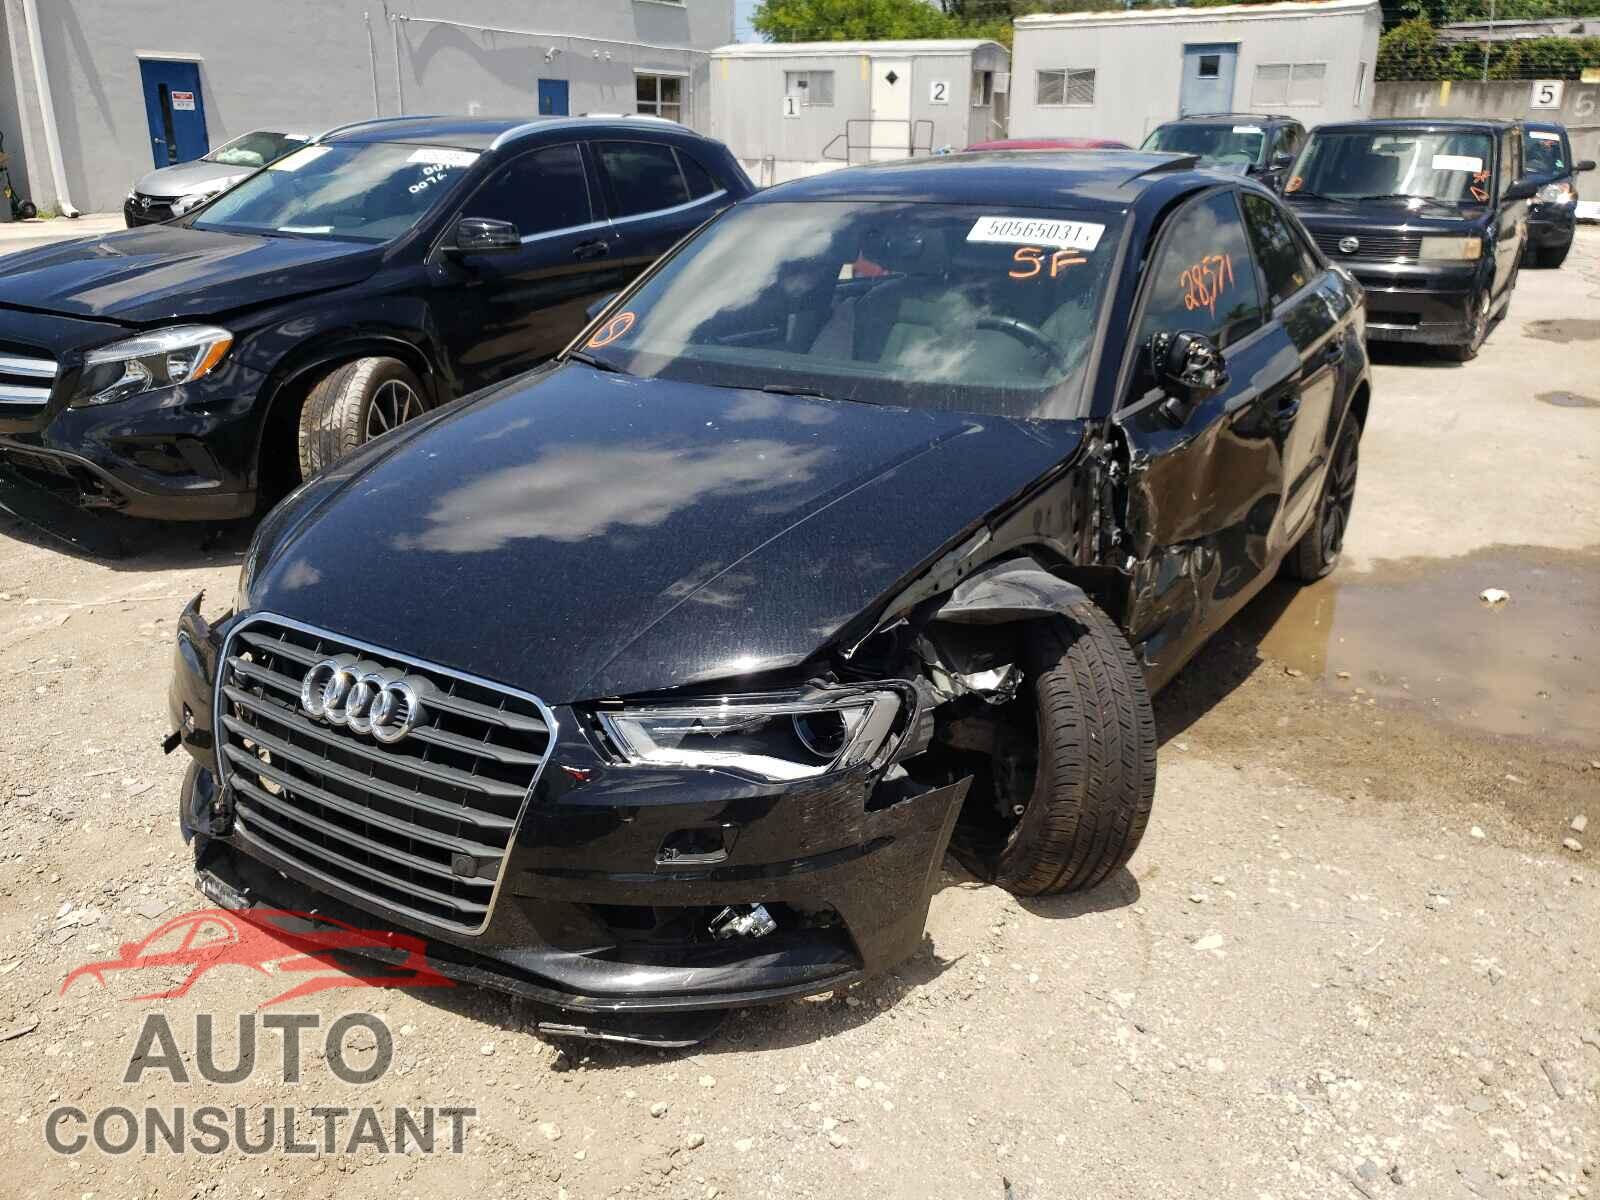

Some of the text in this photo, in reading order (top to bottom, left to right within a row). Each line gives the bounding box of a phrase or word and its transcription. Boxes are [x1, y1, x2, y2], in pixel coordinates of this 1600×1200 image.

[934, 83, 945, 101] 2
[1539, 85, 1553, 104] 5
[788, 98, 795, 114] 1
